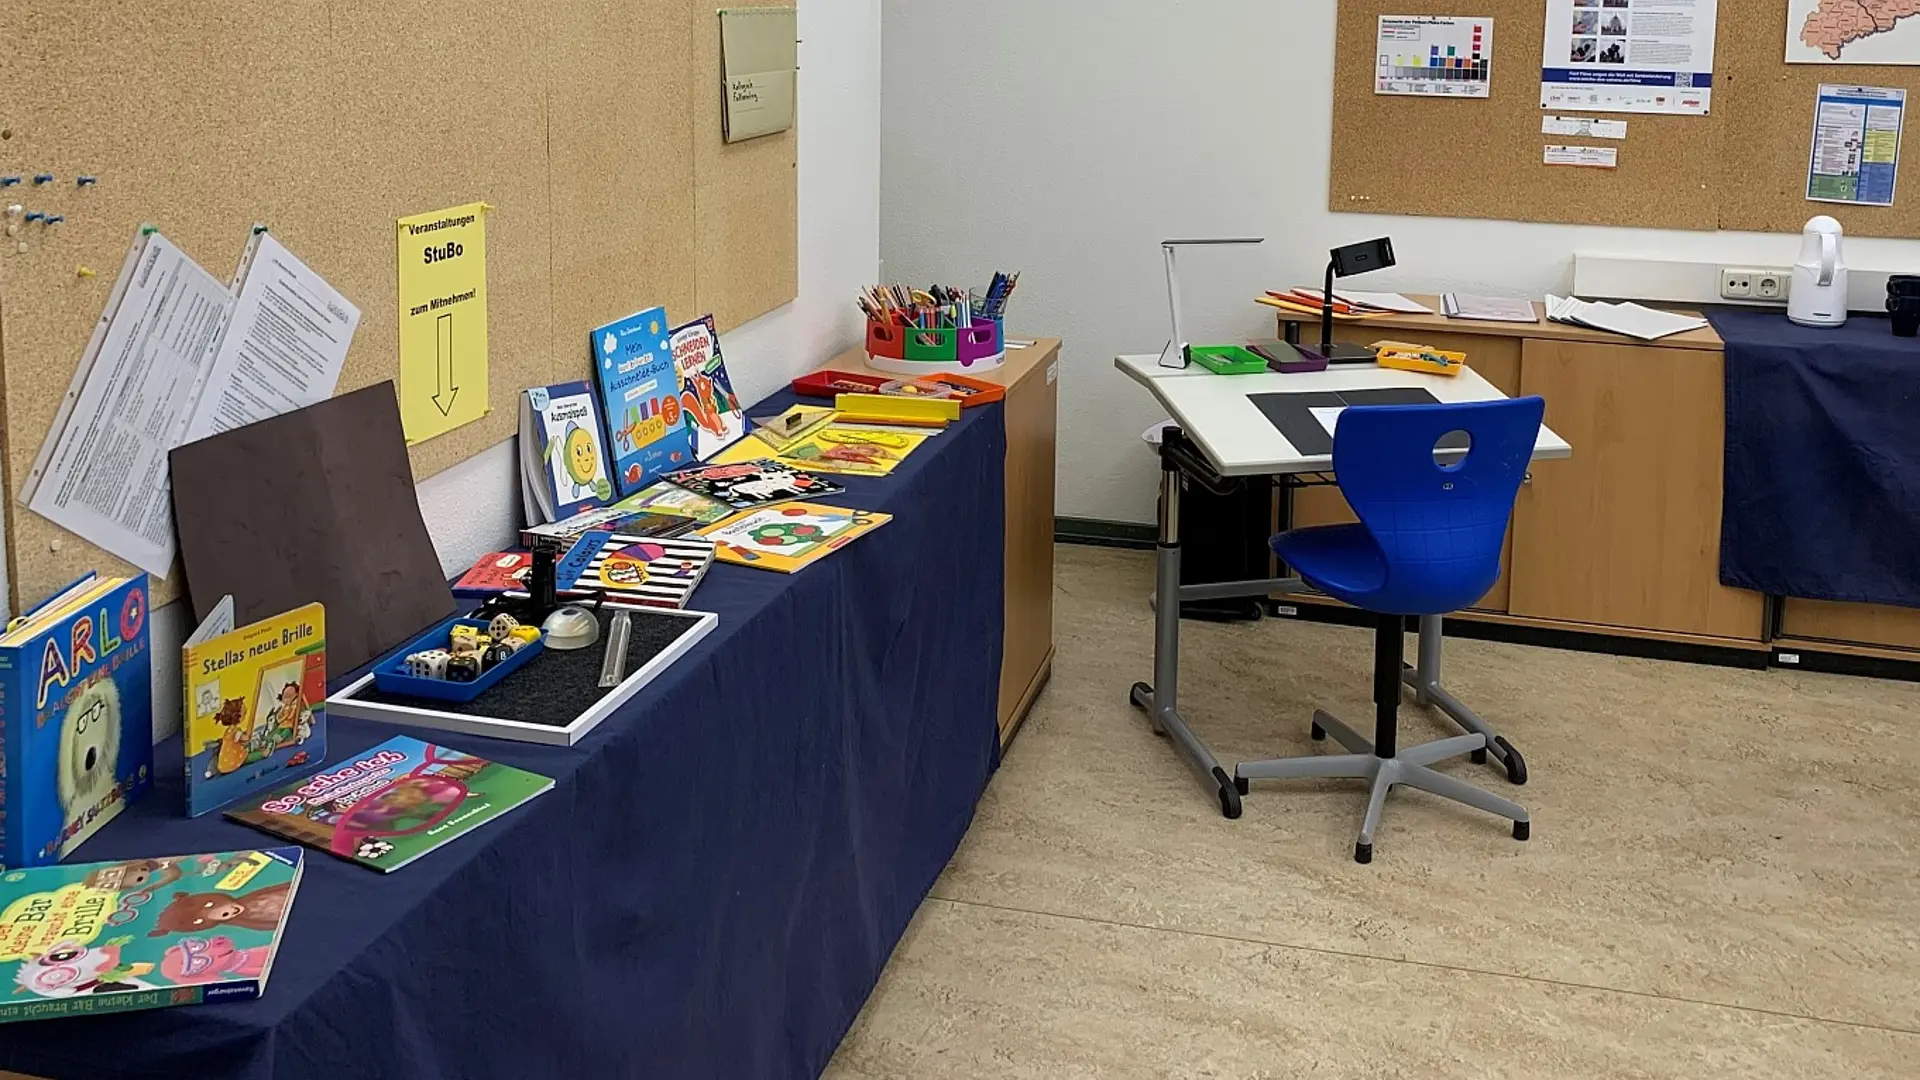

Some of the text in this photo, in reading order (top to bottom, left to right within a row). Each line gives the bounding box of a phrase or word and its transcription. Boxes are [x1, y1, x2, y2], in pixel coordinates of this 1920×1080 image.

[408, 214, 475, 235] Veranstaltungen
[424, 242, 463, 264] StuBo
[410, 287, 476, 316] zum Mitnehmen!
[625, 341, 643, 356] Mein
[681, 350, 706, 371] LERNEN
[37, 588, 145, 710] ARLO
[203, 649, 245, 675] Stellas
[249, 639, 278, 657] neue
[282, 623, 313, 646] Brille
[262, 794, 302, 813] So
[300, 765, 358, 797] sehe
[10, 898, 53, 955] kleine Bär
[33, 889, 81, 951] braucht eine
[62, 896, 107, 939] Brille
[72, 999, 95, 1012] Bär
[99, 993, 141, 1009] kleine
[143, 993, 159, 1004] Der
[25, 1002, 68, 1018] braucht
